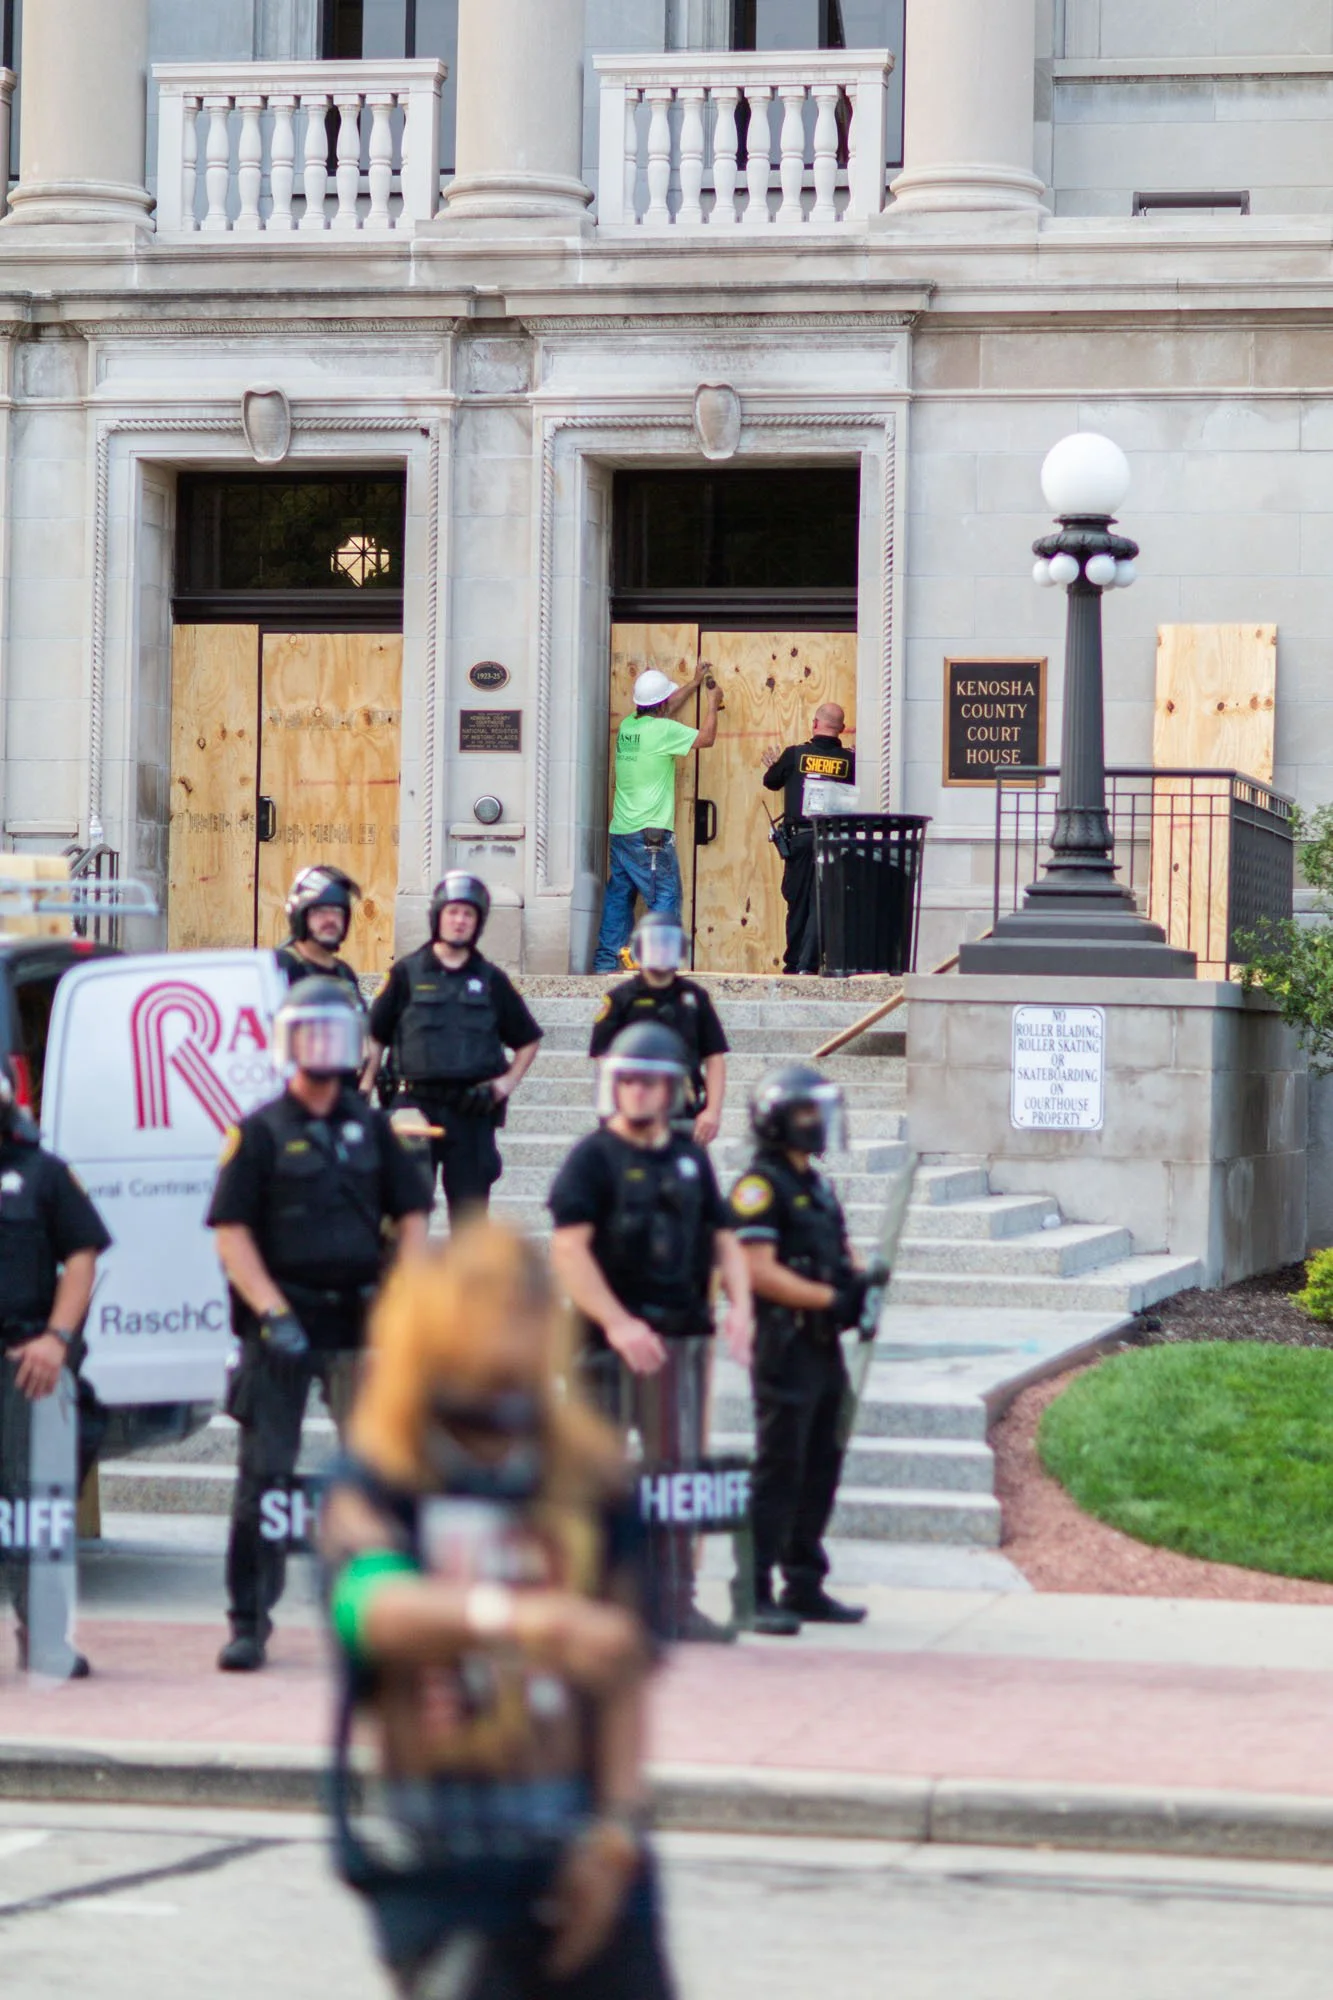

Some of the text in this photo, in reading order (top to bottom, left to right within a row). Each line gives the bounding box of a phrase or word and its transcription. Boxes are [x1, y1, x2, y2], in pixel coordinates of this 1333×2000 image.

[956, 681, 1035, 696] KENOSHA
[961, 703, 1027, 719] COUNTY
[967, 726, 1021, 742] COURT
[966, 749, 1021, 764] HOUSE
[805, 757, 843, 774] SHERIFF
[1052, 1009, 1066, 1022] NO
[1017, 1023, 1054, 1037] ROLLER
[1017, 1038, 1099, 1053] ROLLER SKATING
[1051, 1053, 1065, 1066] OR
[1017, 1068, 1098, 1082] SKATEBOARDING
[1050, 1083, 1064, 1095] ON
[1024, 1097, 1089, 1111] COURTHOUSE
[1032, 1111, 1080, 1125] PROPERTY
